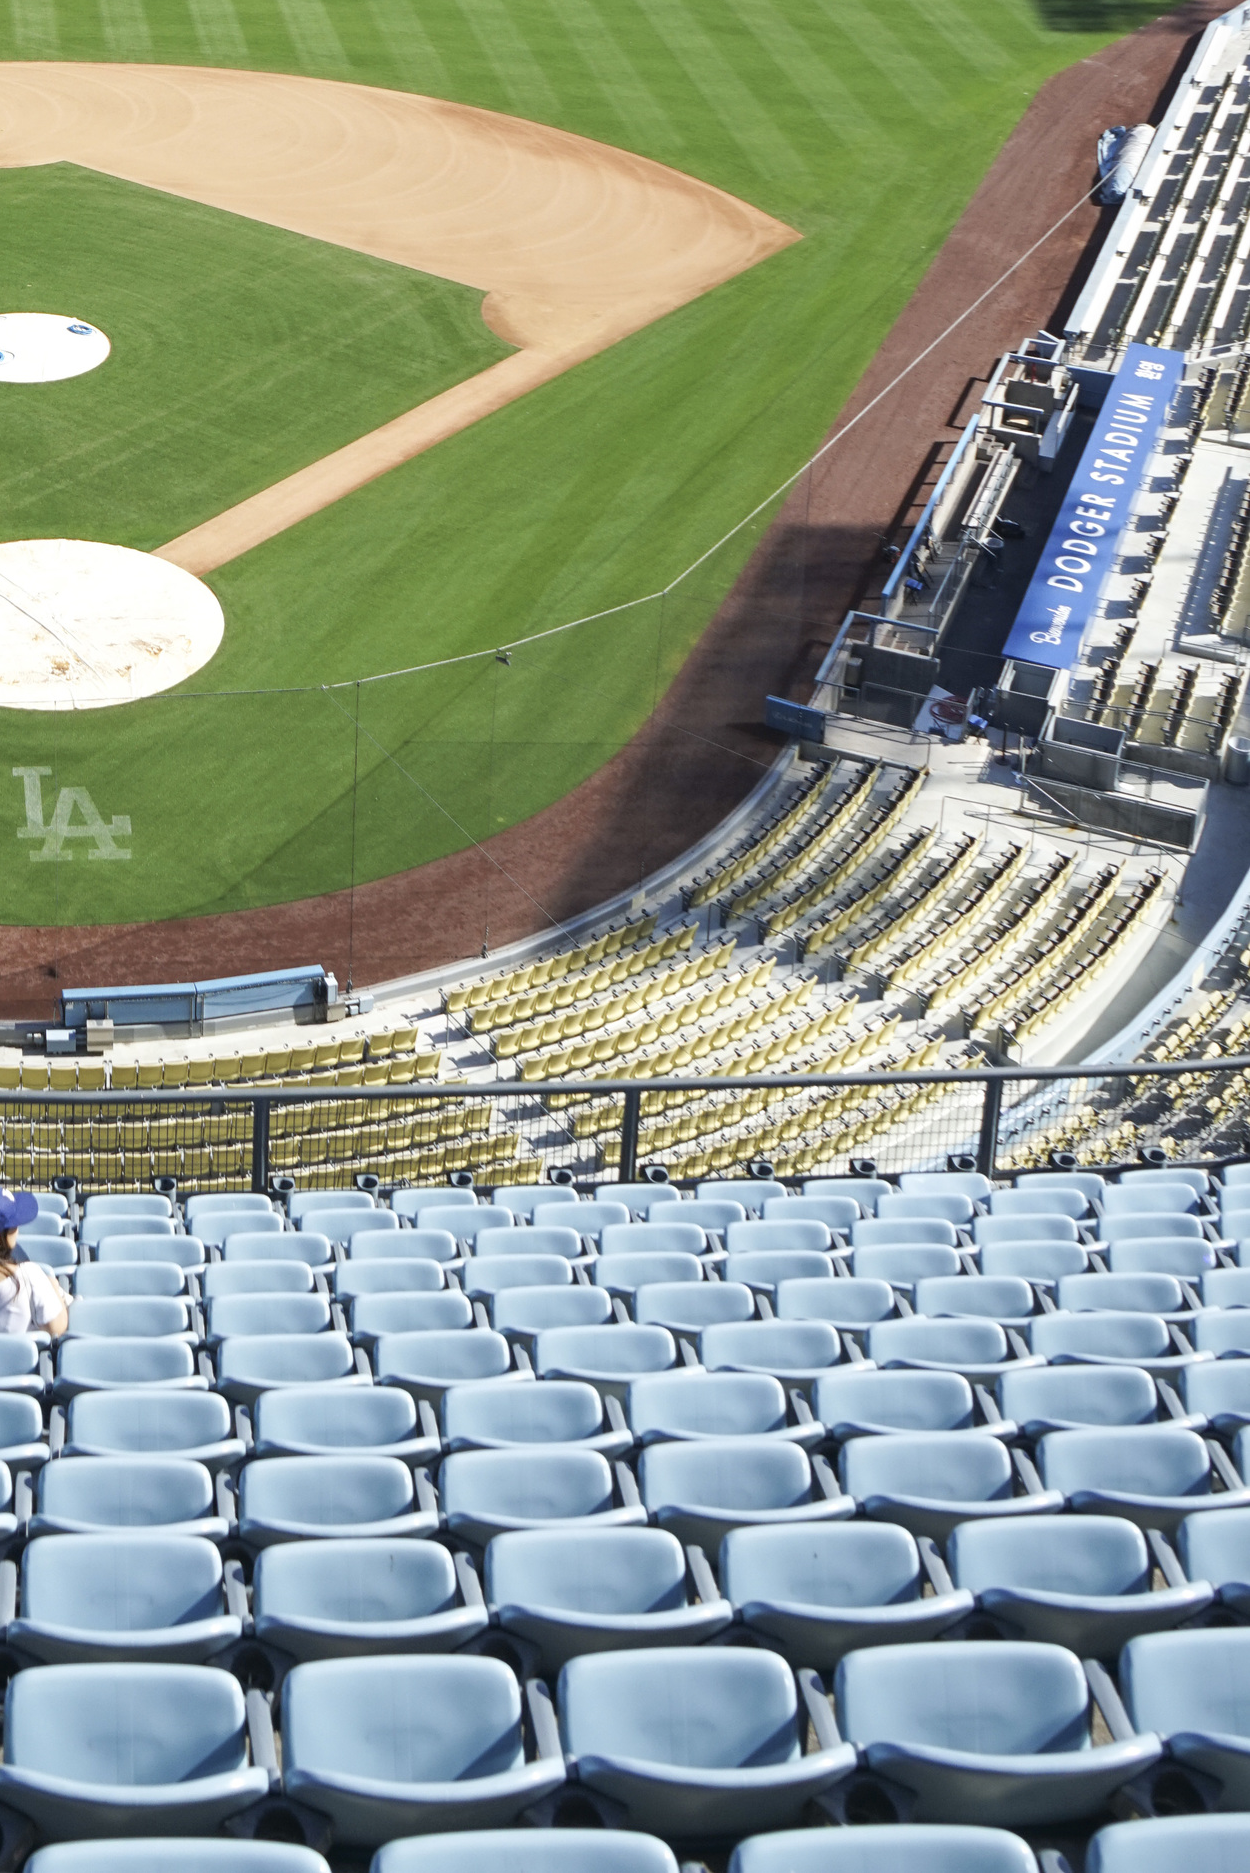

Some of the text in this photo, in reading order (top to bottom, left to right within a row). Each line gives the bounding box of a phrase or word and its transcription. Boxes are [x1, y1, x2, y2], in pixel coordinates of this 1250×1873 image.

[1047, 393, 1155, 593] DODGER STADIUM
[1030, 604, 1072, 645] Bienvenidos
[12, 766, 132, 862] LA
